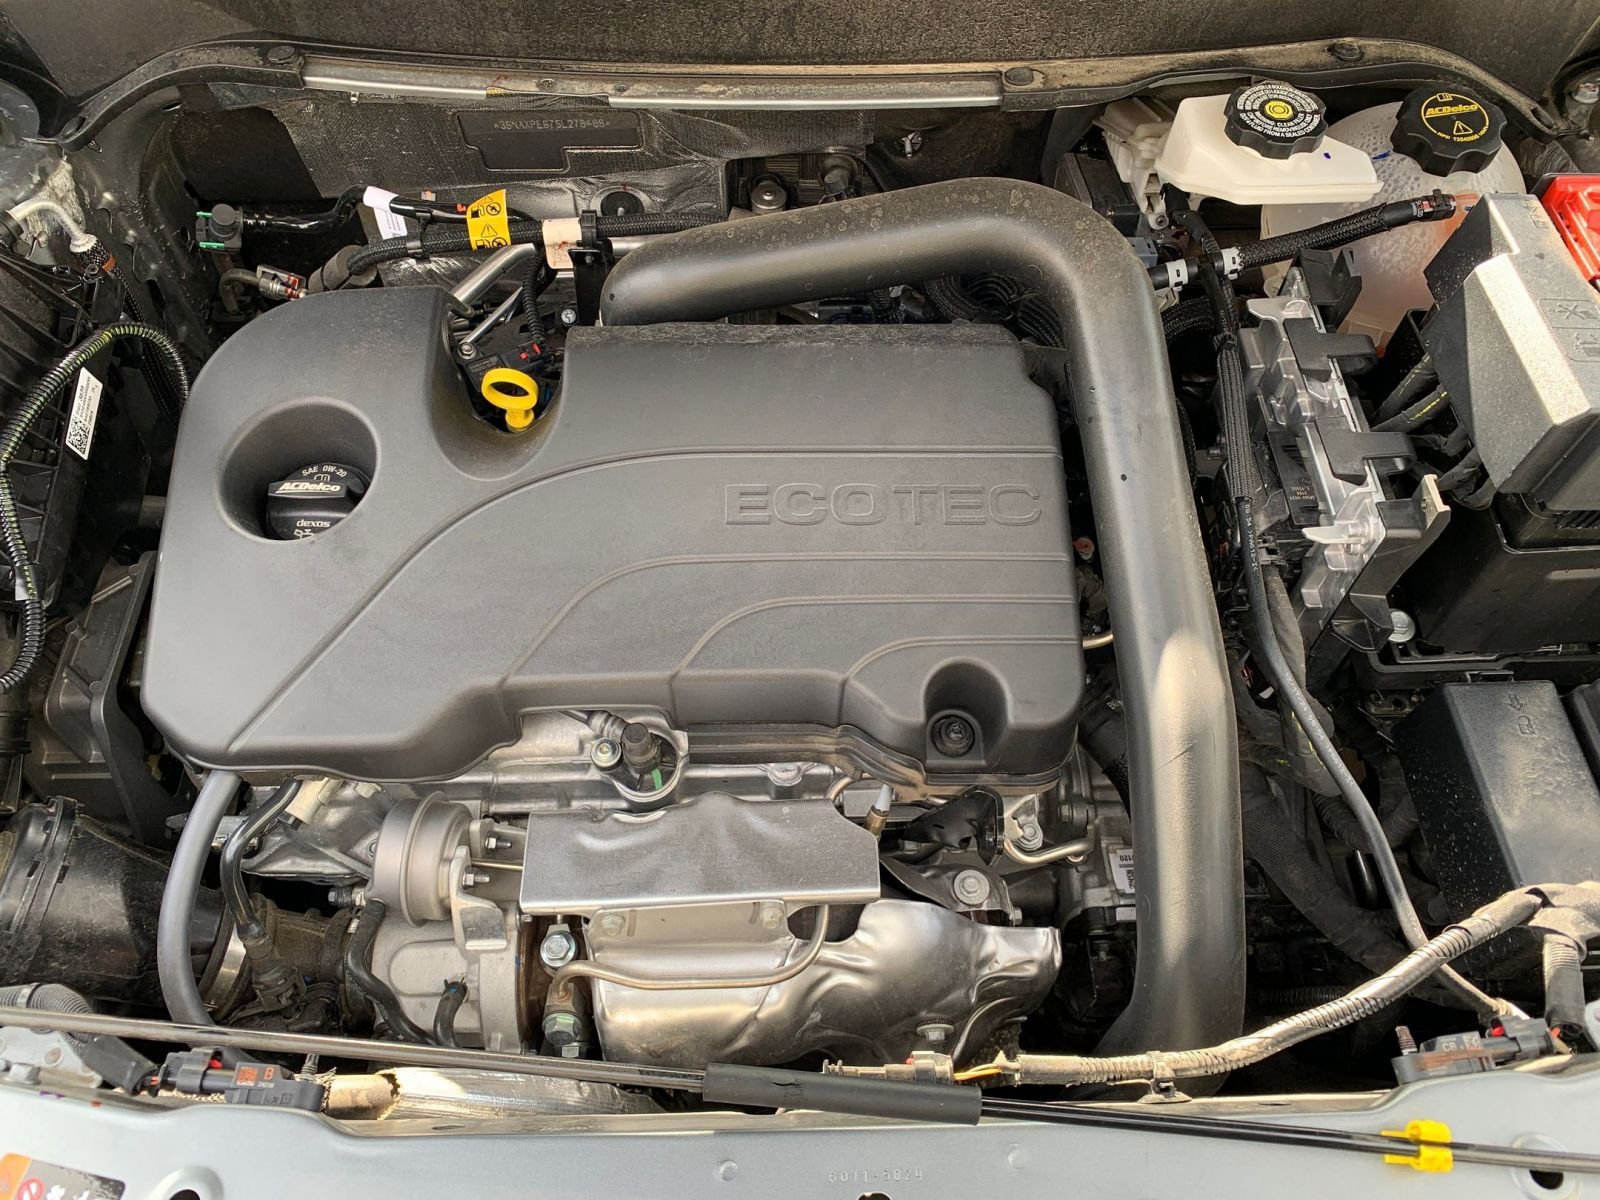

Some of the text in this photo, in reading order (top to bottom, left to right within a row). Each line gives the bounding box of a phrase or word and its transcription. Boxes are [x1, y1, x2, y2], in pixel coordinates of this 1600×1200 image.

[1426, 104, 1479, 116] ACDelco
[302, 464, 348, 478] SAE 0W-20
[277, 482, 342, 493] ACDelco
[724, 482, 1043, 526] ECOTEC
[296, 519, 332, 528] dexos
